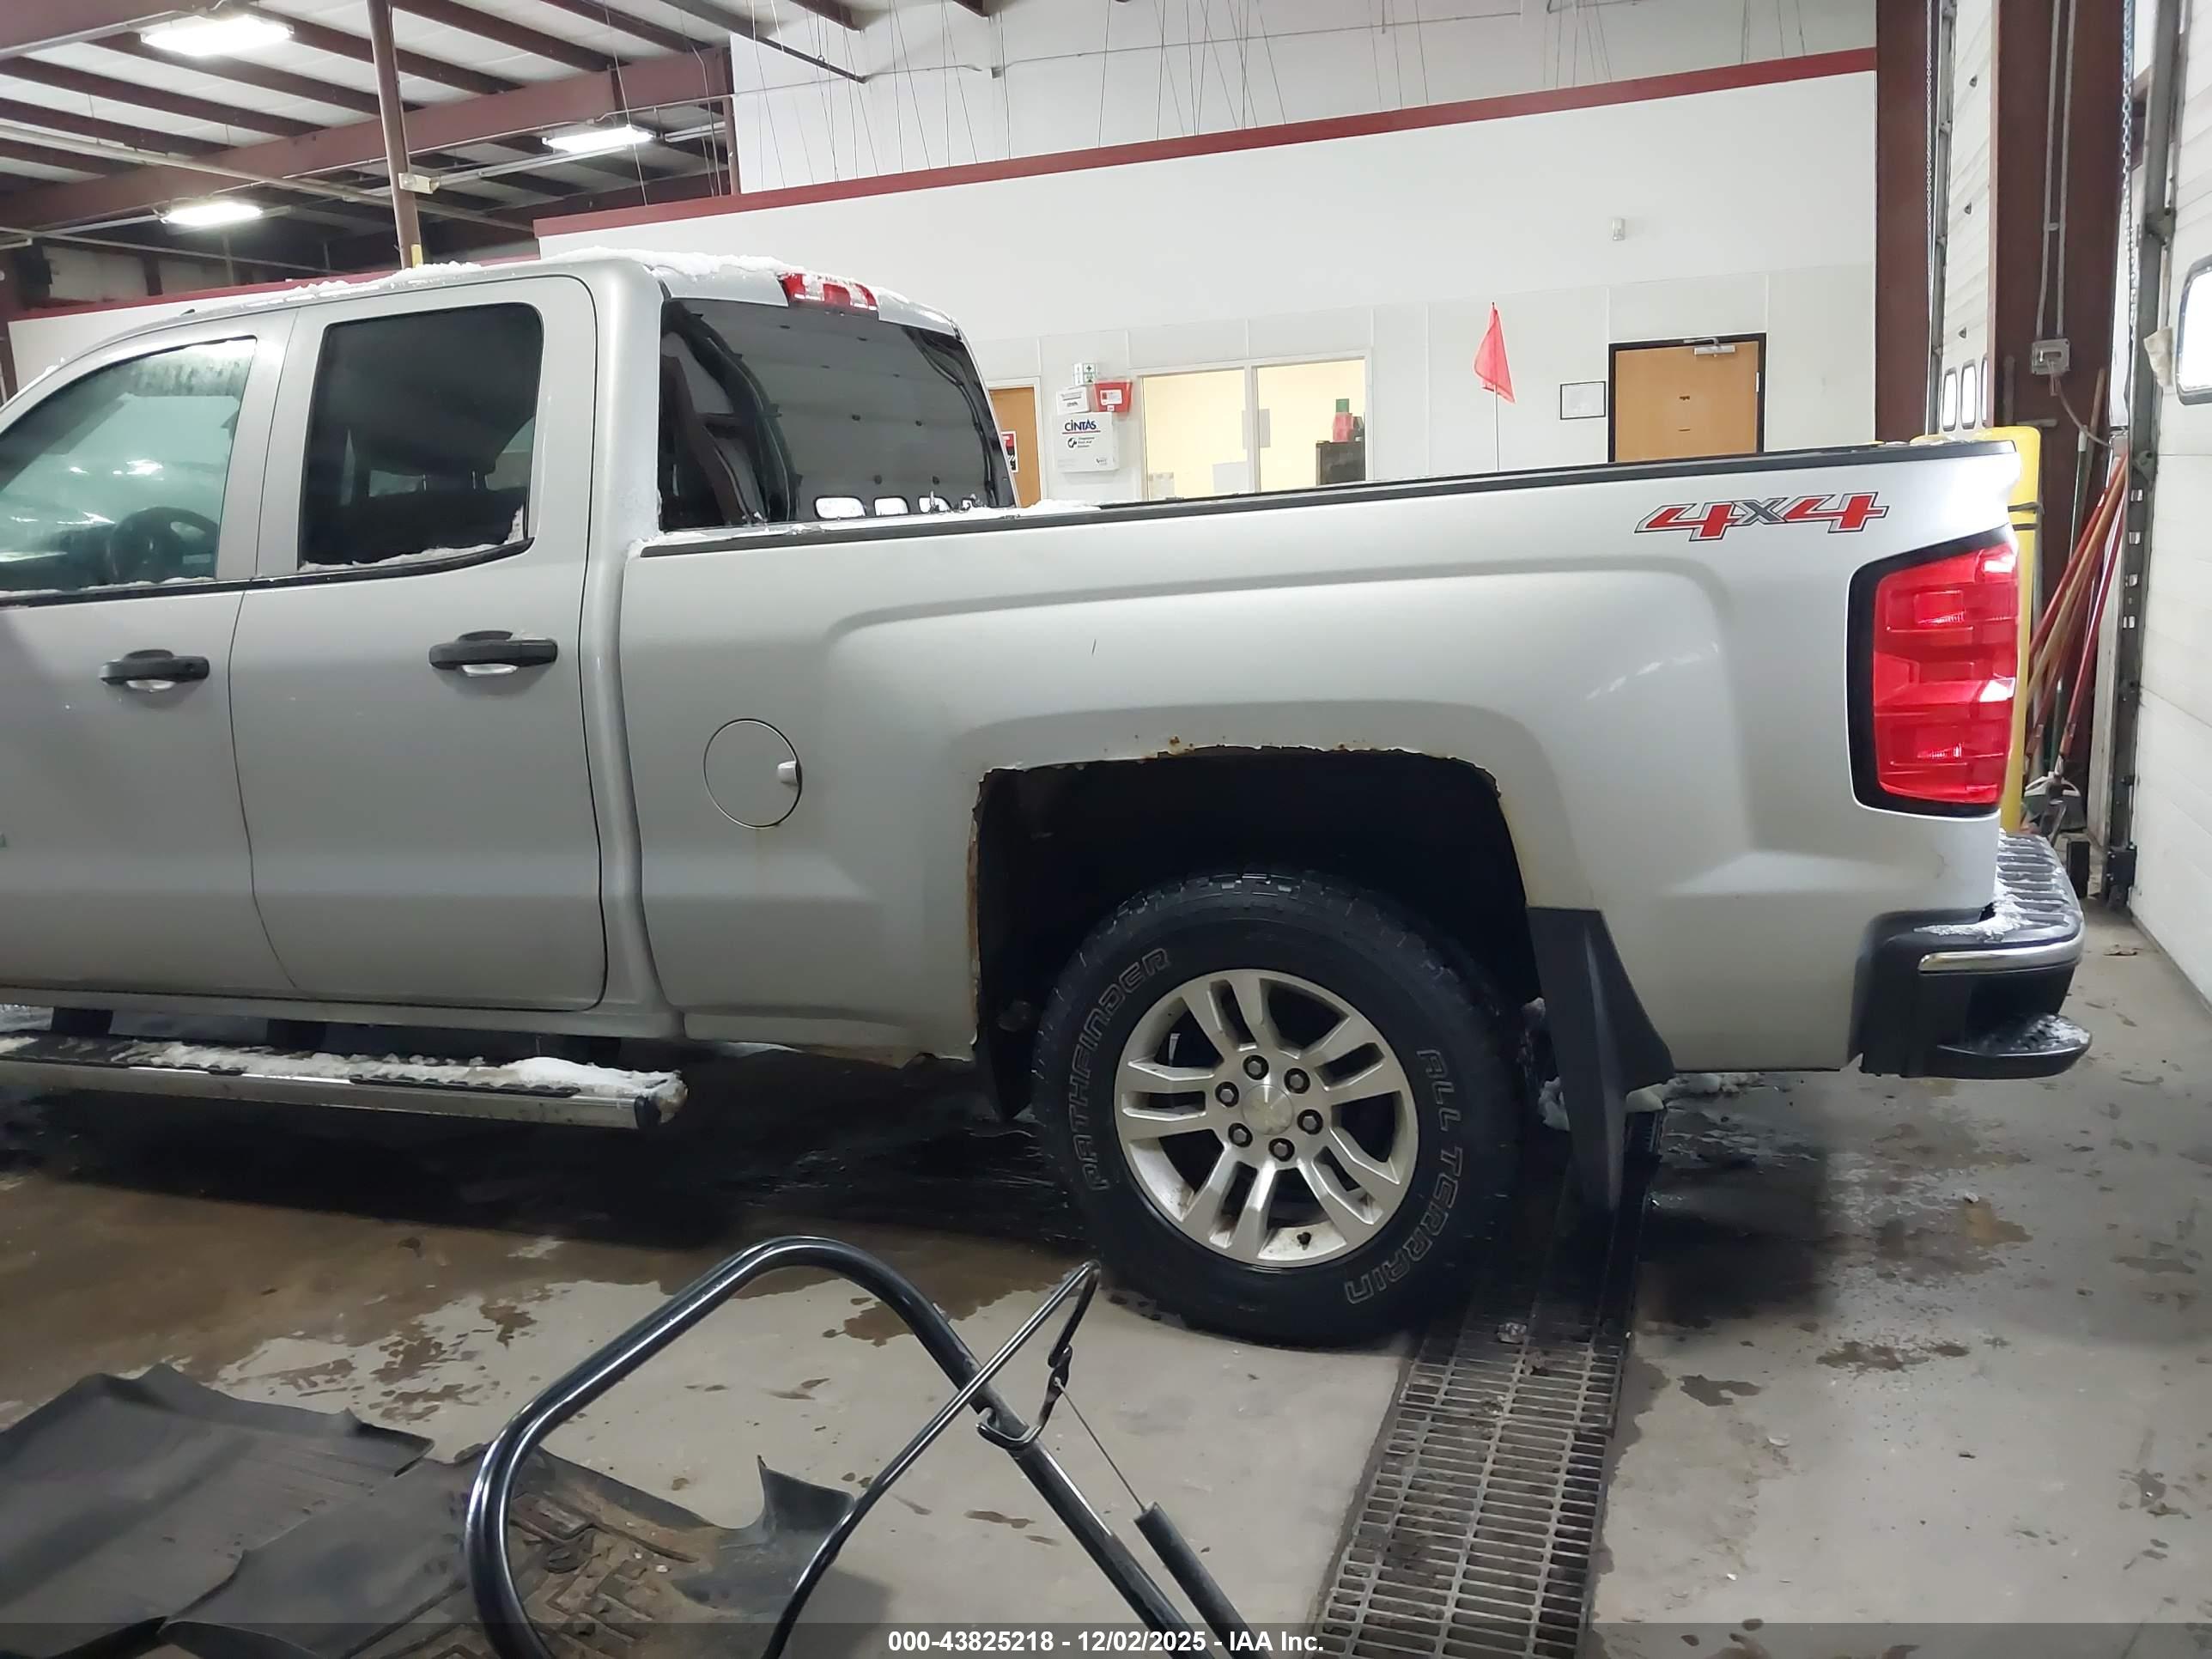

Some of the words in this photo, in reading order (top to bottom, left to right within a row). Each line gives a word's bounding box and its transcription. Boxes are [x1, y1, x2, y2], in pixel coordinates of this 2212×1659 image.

[1064, 418, 1097, 432] CINTAS
[1069, 948, 1171, 1191] PATHFINDER
[1417, 1048, 1462, 1132] ALL
[1344, 1146, 1463, 1304] TERRAIN
